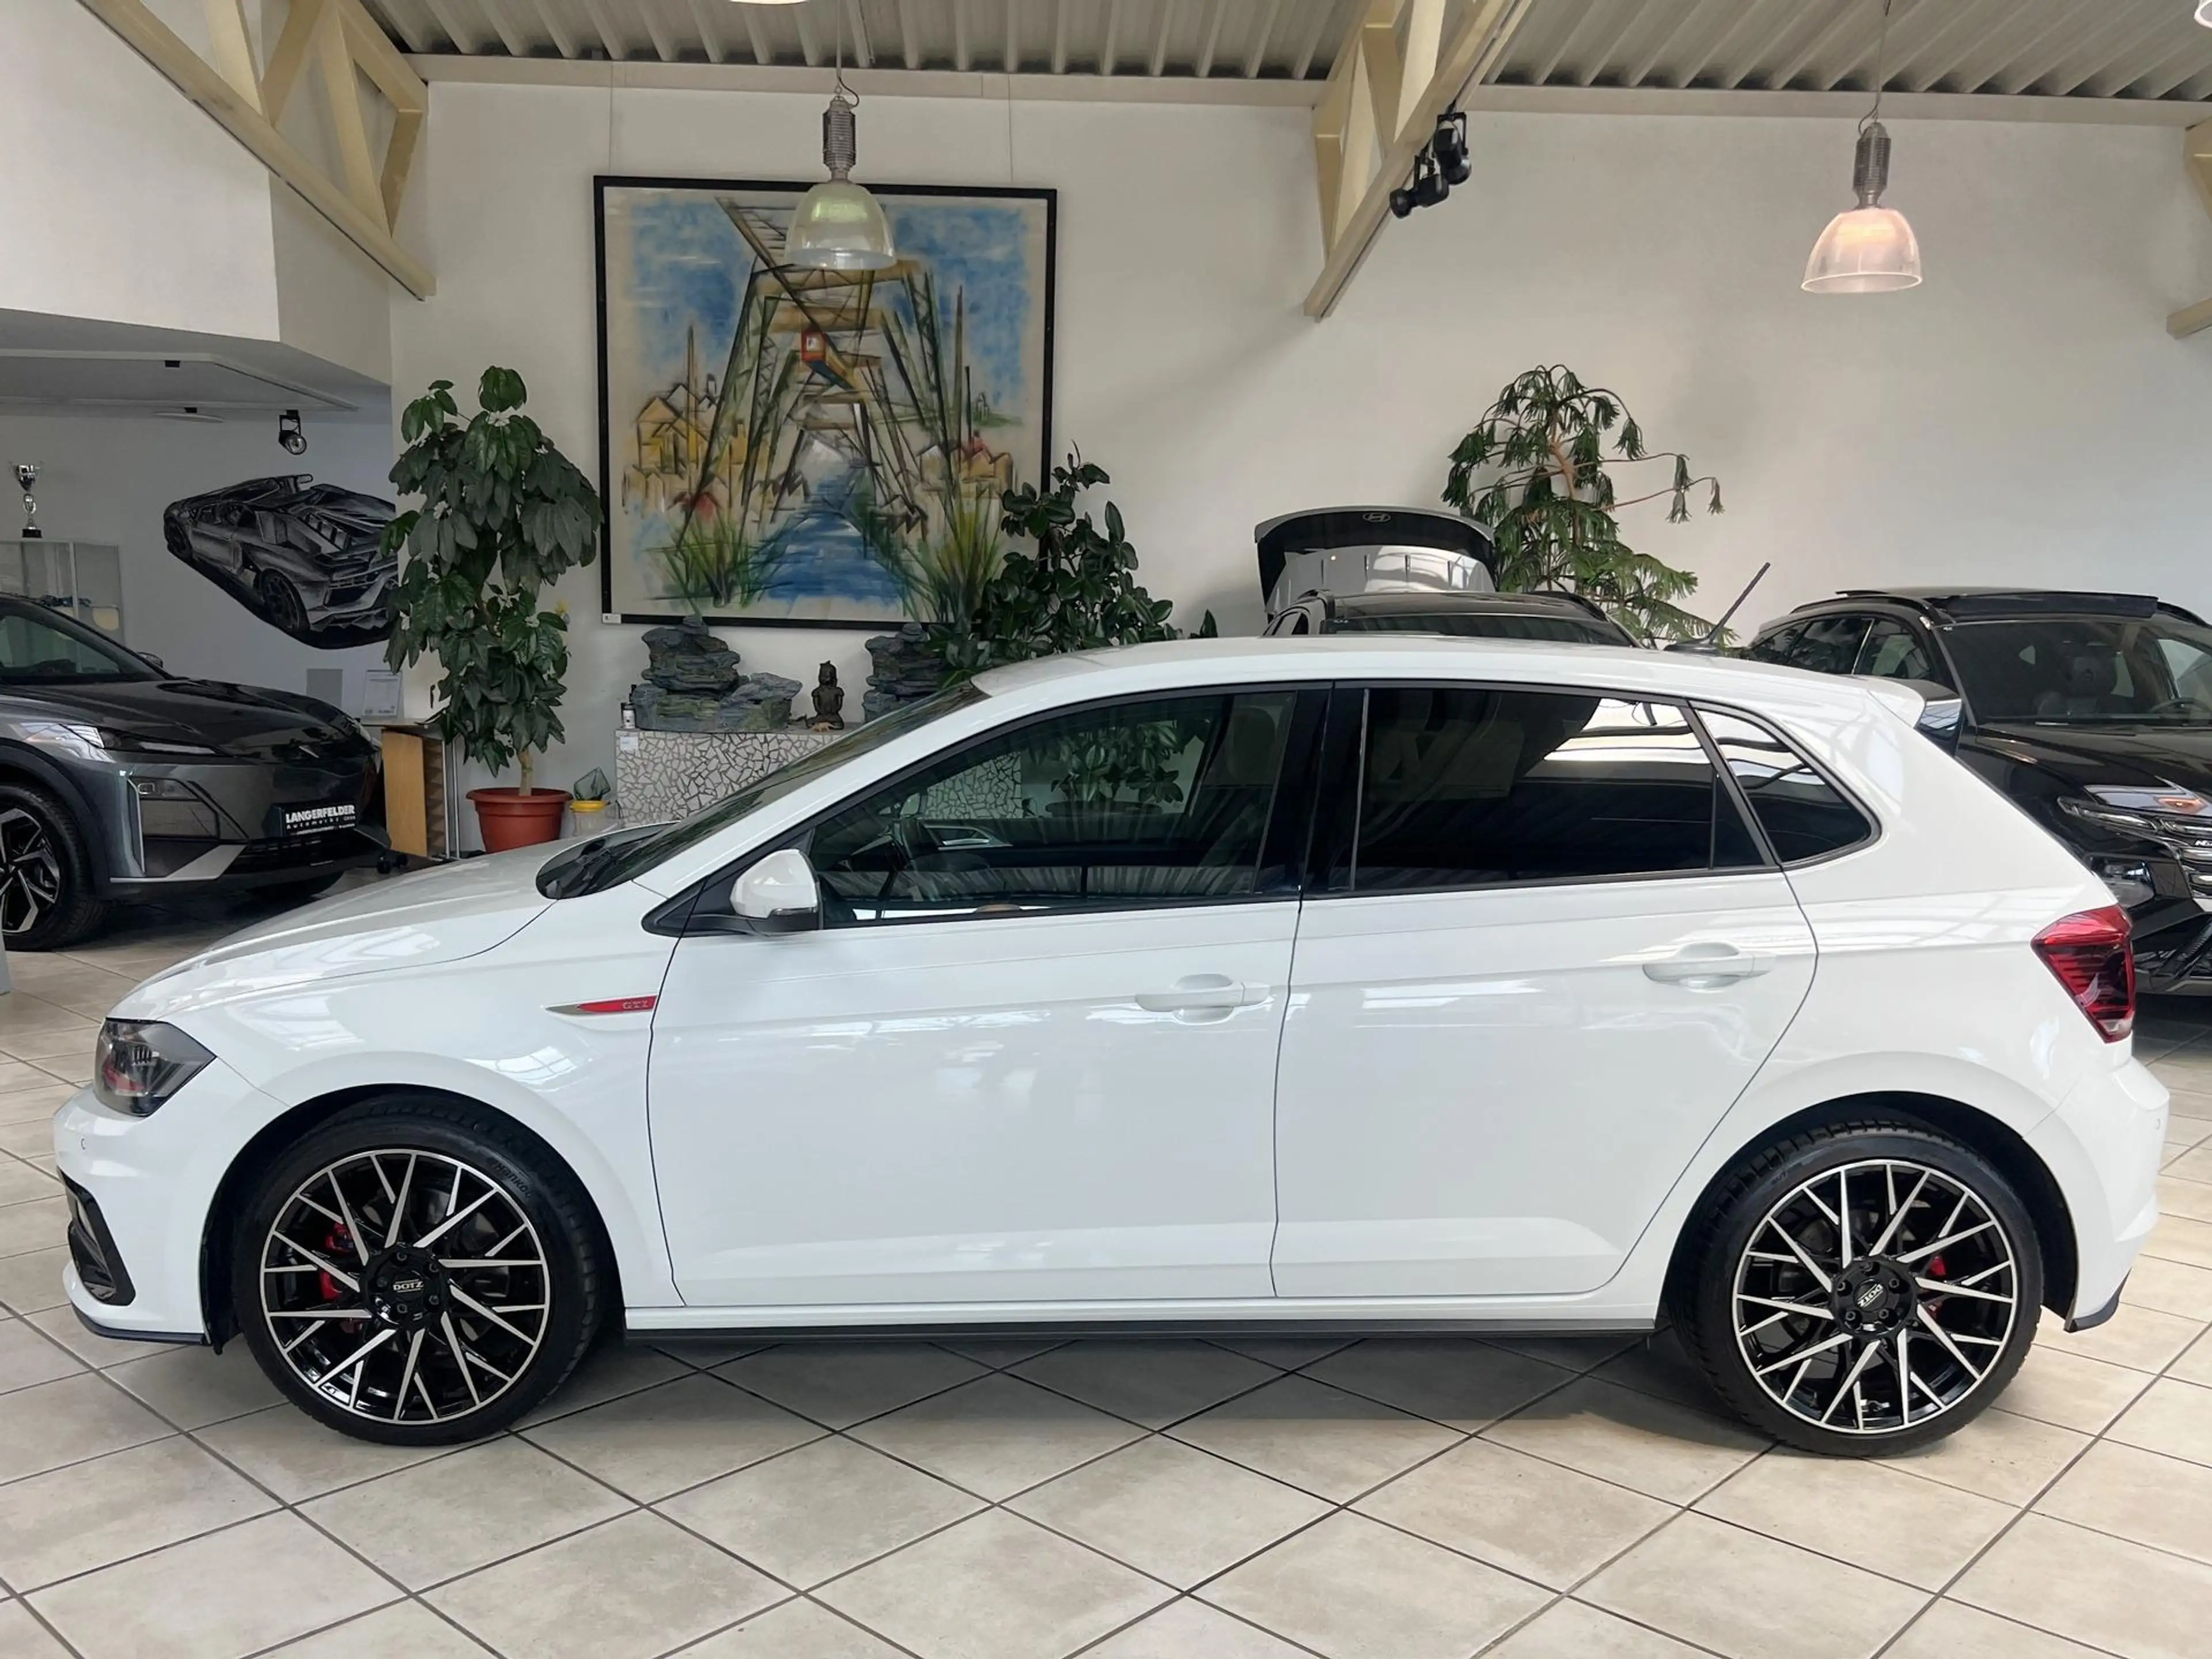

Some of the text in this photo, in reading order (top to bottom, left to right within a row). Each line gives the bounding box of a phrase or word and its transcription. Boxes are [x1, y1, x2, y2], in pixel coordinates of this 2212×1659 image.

[286, 805, 355, 823] LANGERFELDER
[622, 1000, 649, 1009] GTI
[493, 1161, 536, 1199] Hankoo
[392, 1281, 425, 1291] DOTZ
[1857, 1283, 1884, 1308] DOTZ
